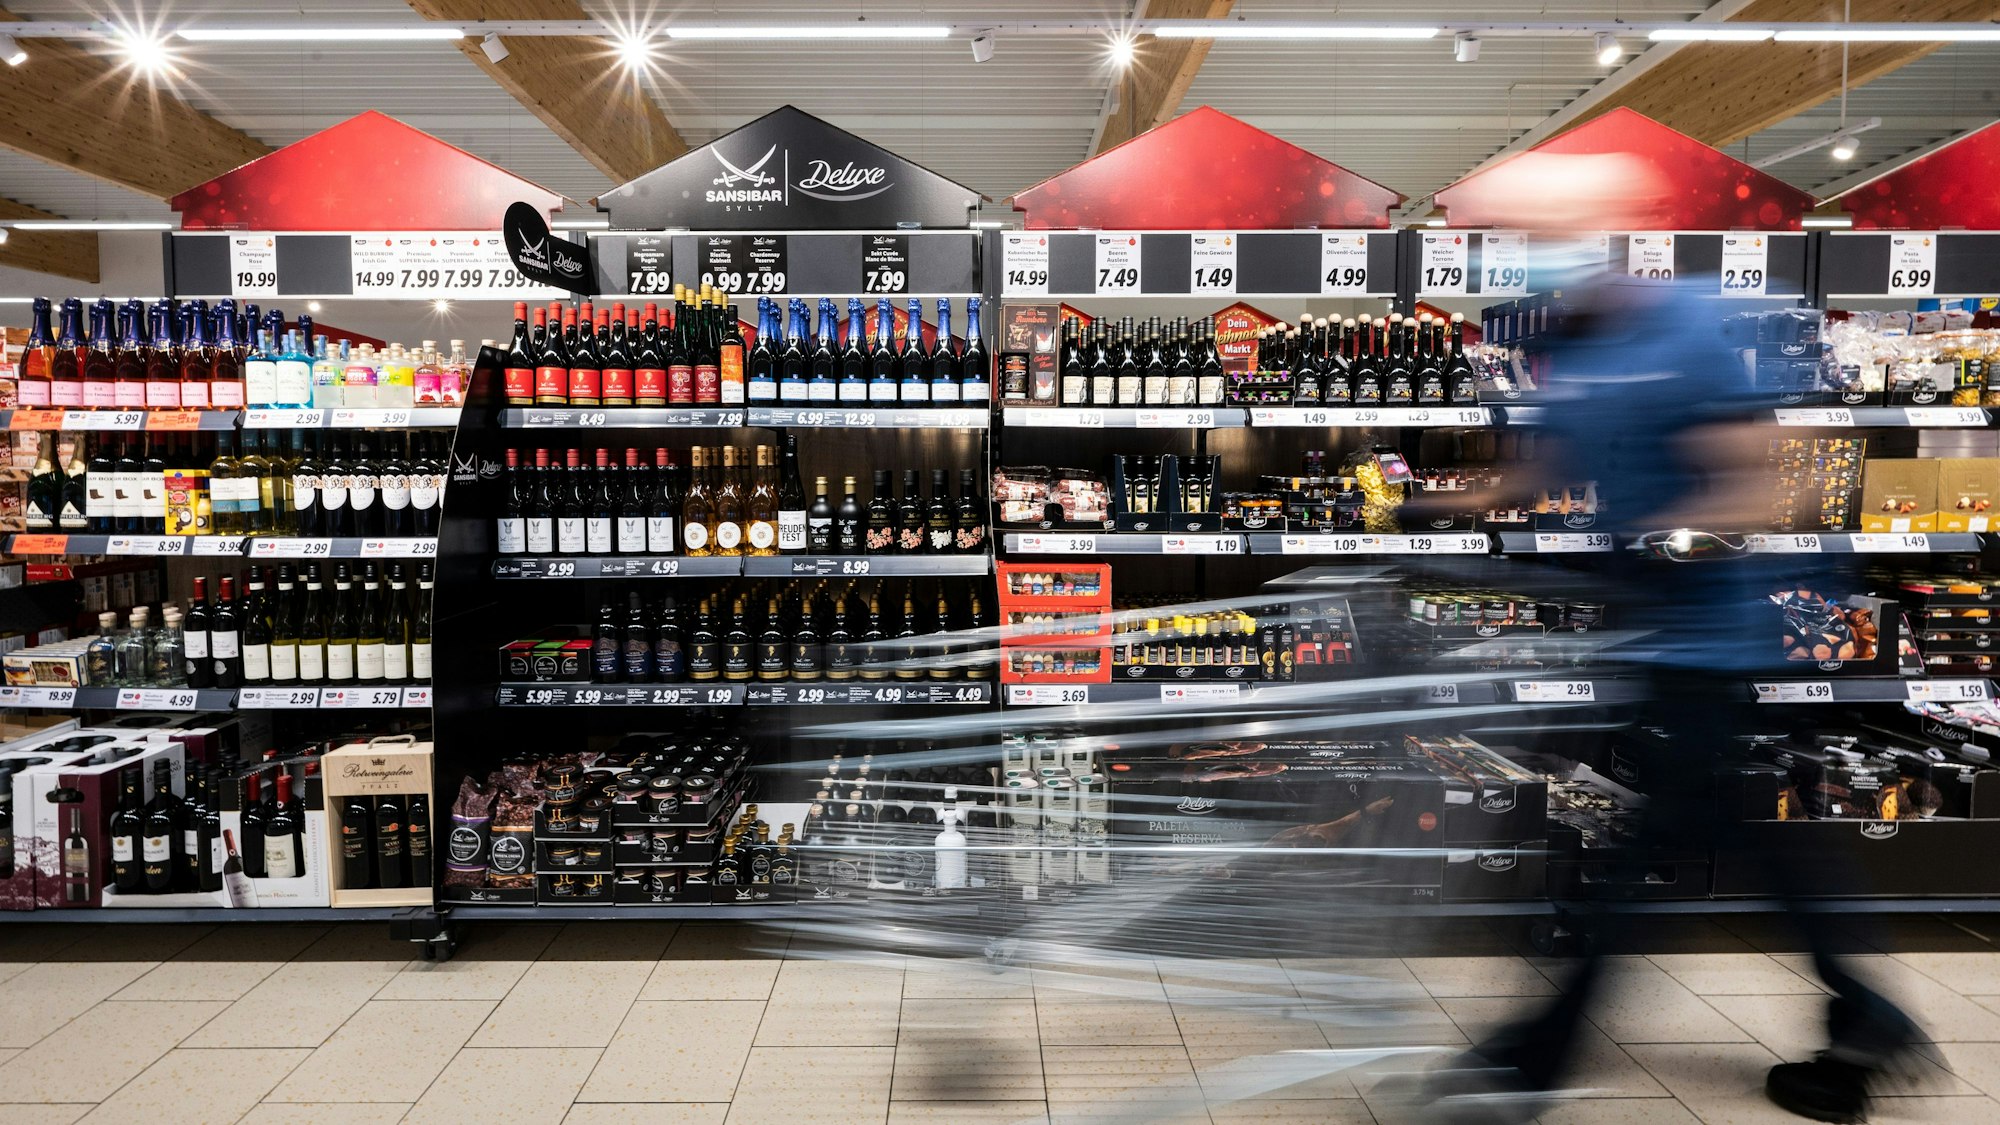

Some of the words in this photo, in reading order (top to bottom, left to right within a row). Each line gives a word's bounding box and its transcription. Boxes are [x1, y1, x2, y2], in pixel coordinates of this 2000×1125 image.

[799, 160, 885, 191] Deluxe
[706, 190, 782, 202] SANSIBAR
[519, 255, 549, 270] SANSIBAR
[553, 251, 582, 272] Deluxe
[237, 272, 276, 287] 19.99
[355, 271, 394, 287] 14.99
[401, 269, 440, 288] 7.99
[444, 269, 483, 288] 7.99
[488, 269, 526, 288] 7.99
[631, 272, 670, 292] 7.99
[746, 272, 786, 292] 7.99
[866, 271, 905, 292] 7.99
[1008, 270, 1048, 286] 14.99
[1098, 268, 1138, 287] 7.49
[1194, 268, 1233, 287] 1.49
[1326, 268, 1366, 286] 4.99
[1425, 267, 1462, 287] 1.79
[1487, 267, 1526, 287] 1.99
[1723, 269, 1762, 289] 2.59
[1891, 270, 1931, 288] 6.99
[1227, 318, 1248, 328] Dein
[1224, 344, 1251, 354] Markt
[114, 414, 139, 425] 5.99
[296, 413, 320, 424] 2.99
[382, 413, 406, 423] 3.99
[578, 413, 605, 425] 8.49
[717, 413, 743, 425] 7.99
[797, 412, 823, 424] 6.99
[844, 412, 875, 425] 12.99
[939, 412, 970, 425] 14.99
[1078, 413, 1101, 424] 1.79
[1187, 414, 1211, 424] 2.99
[1303, 413, 1326, 424] 1.49
[1355, 411, 1378, 421] 2.99
[1458, 411, 1480, 422] 1.19
[1826, 411, 1850, 422] 3.99
[1957, 412, 1981, 422] 3.99
[479, 460, 502, 474] Deluxe
[1567, 516, 1593, 526] Deluxe
[782, 533, 800, 542] FEST
[1587, 536, 1610, 548] 3.99
[1794, 538, 1817, 549] 1.99
[1902, 537, 1925, 548] 1.49
[158, 541, 182, 552] 8.99
[218, 541, 242, 552] 9.99
[303, 543, 328, 554] 2.99
[412, 543, 436, 554] 2.99
[1070, 539, 1093, 550] 3.99
[1215, 540, 1237, 552] 1.19
[1334, 540, 1357, 552] 1.09
[1409, 539, 1432, 551] 1.29
[1461, 540, 1484, 551] 3.99
[547, 563, 575, 576] 2.99
[651, 561, 678, 574] 4.99
[843, 561, 870, 574] 8.99
[797, 689, 824, 702] 2.99
[875, 688, 902, 701] 4.99
[956, 688, 982, 701] 4.49
[1431, 686, 1454, 698] 2.99
[1567, 684, 1590, 695] 2.99
[1806, 685, 1829, 697] 6.99
[1960, 685, 1982, 697] 1.59
[48, 691, 73, 701] 19.99
[169, 695, 194, 706] 4.99
[290, 693, 314, 704] 2.99
[372, 692, 397, 704] 5.79
[526, 690, 553, 703] 5.99
[574, 690, 601, 703] 5.99
[653, 690, 679, 703] 2.99
[707, 689, 732, 703] 1.99
[1062, 690, 1085, 702] 3.69
[1927, 723, 1968, 742] Deluxe
[342, 764, 414, 781] Rotweingalerie
[1177, 796, 1216, 810] Deluxe
[1484, 798, 1512, 809] Deluxe
[1149, 821, 1190, 832] PALETA
[1865, 822, 1894, 834] Deluxe
[1172, 833, 1223, 844] RESERVA
[1483, 856, 1512, 867] Deluxe
